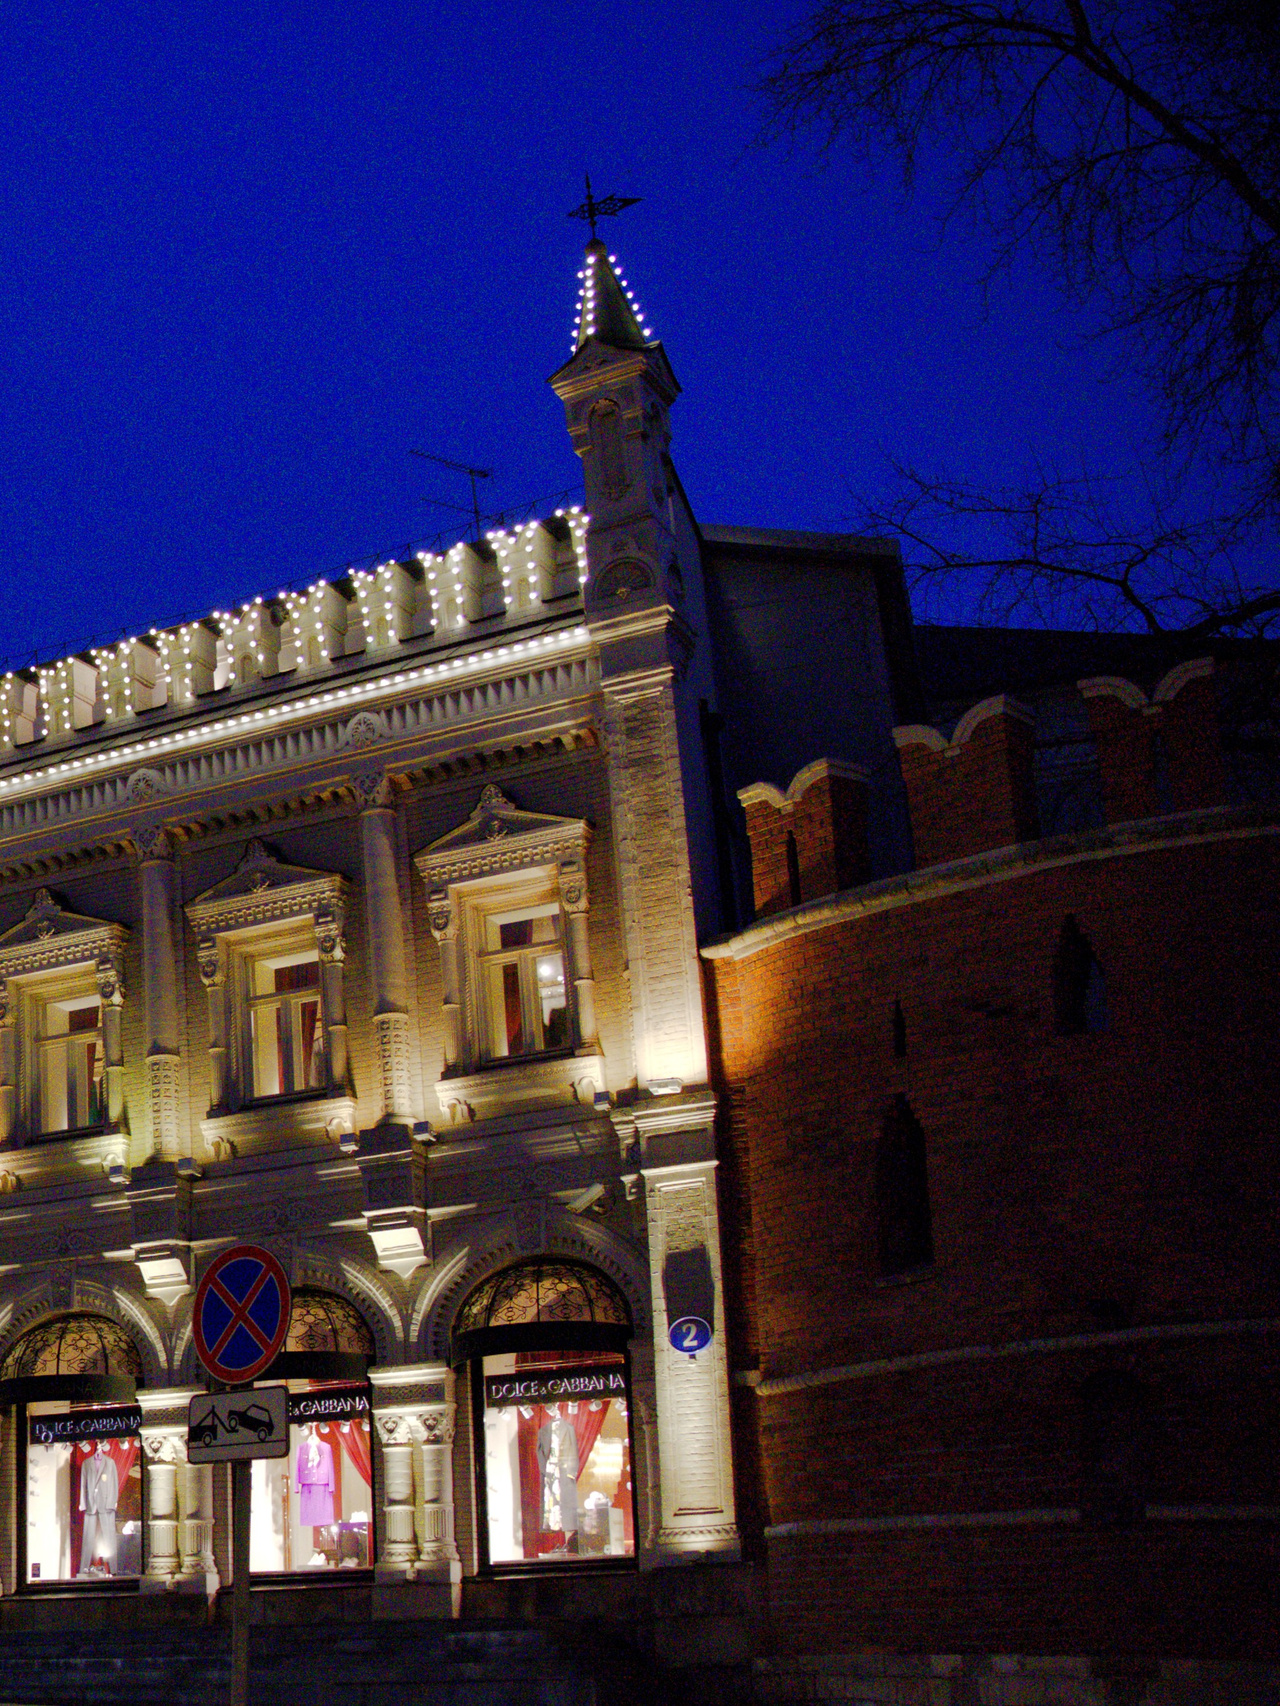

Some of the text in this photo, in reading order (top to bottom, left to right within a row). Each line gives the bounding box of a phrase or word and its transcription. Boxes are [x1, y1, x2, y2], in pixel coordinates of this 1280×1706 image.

[682, 1323, 698, 1347] 2
[492, 1380, 539, 1398] DOLCE
[548, 1373, 626, 1394] GABBANA
[300, 1396, 370, 1415] GABBANA
[35, 1420, 74, 1443] DOLCE
[81, 1415, 141, 1433] GABBANA
